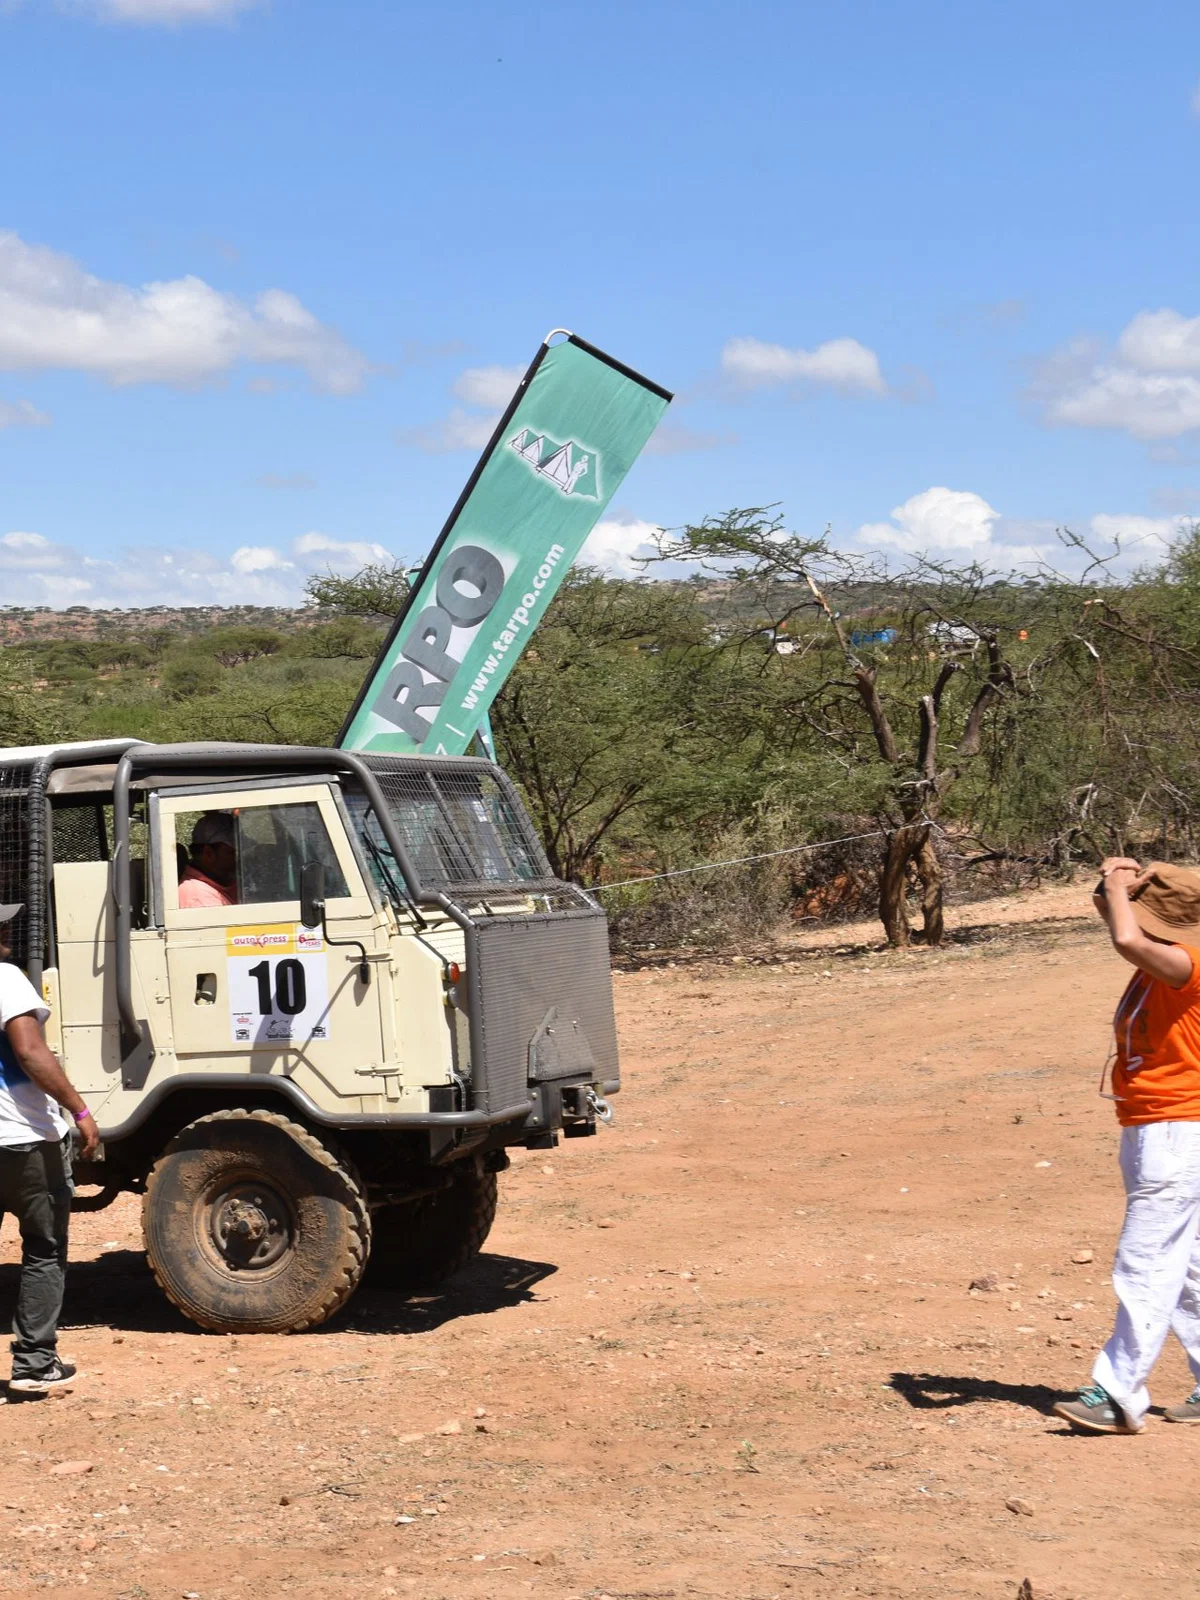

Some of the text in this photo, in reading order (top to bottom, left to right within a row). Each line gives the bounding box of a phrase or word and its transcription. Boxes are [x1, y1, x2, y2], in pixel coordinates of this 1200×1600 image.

[362, 545, 505, 752] RPO
[460, 543, 564, 710] www.tarpo.com
[248, 958, 307, 1016] 10
